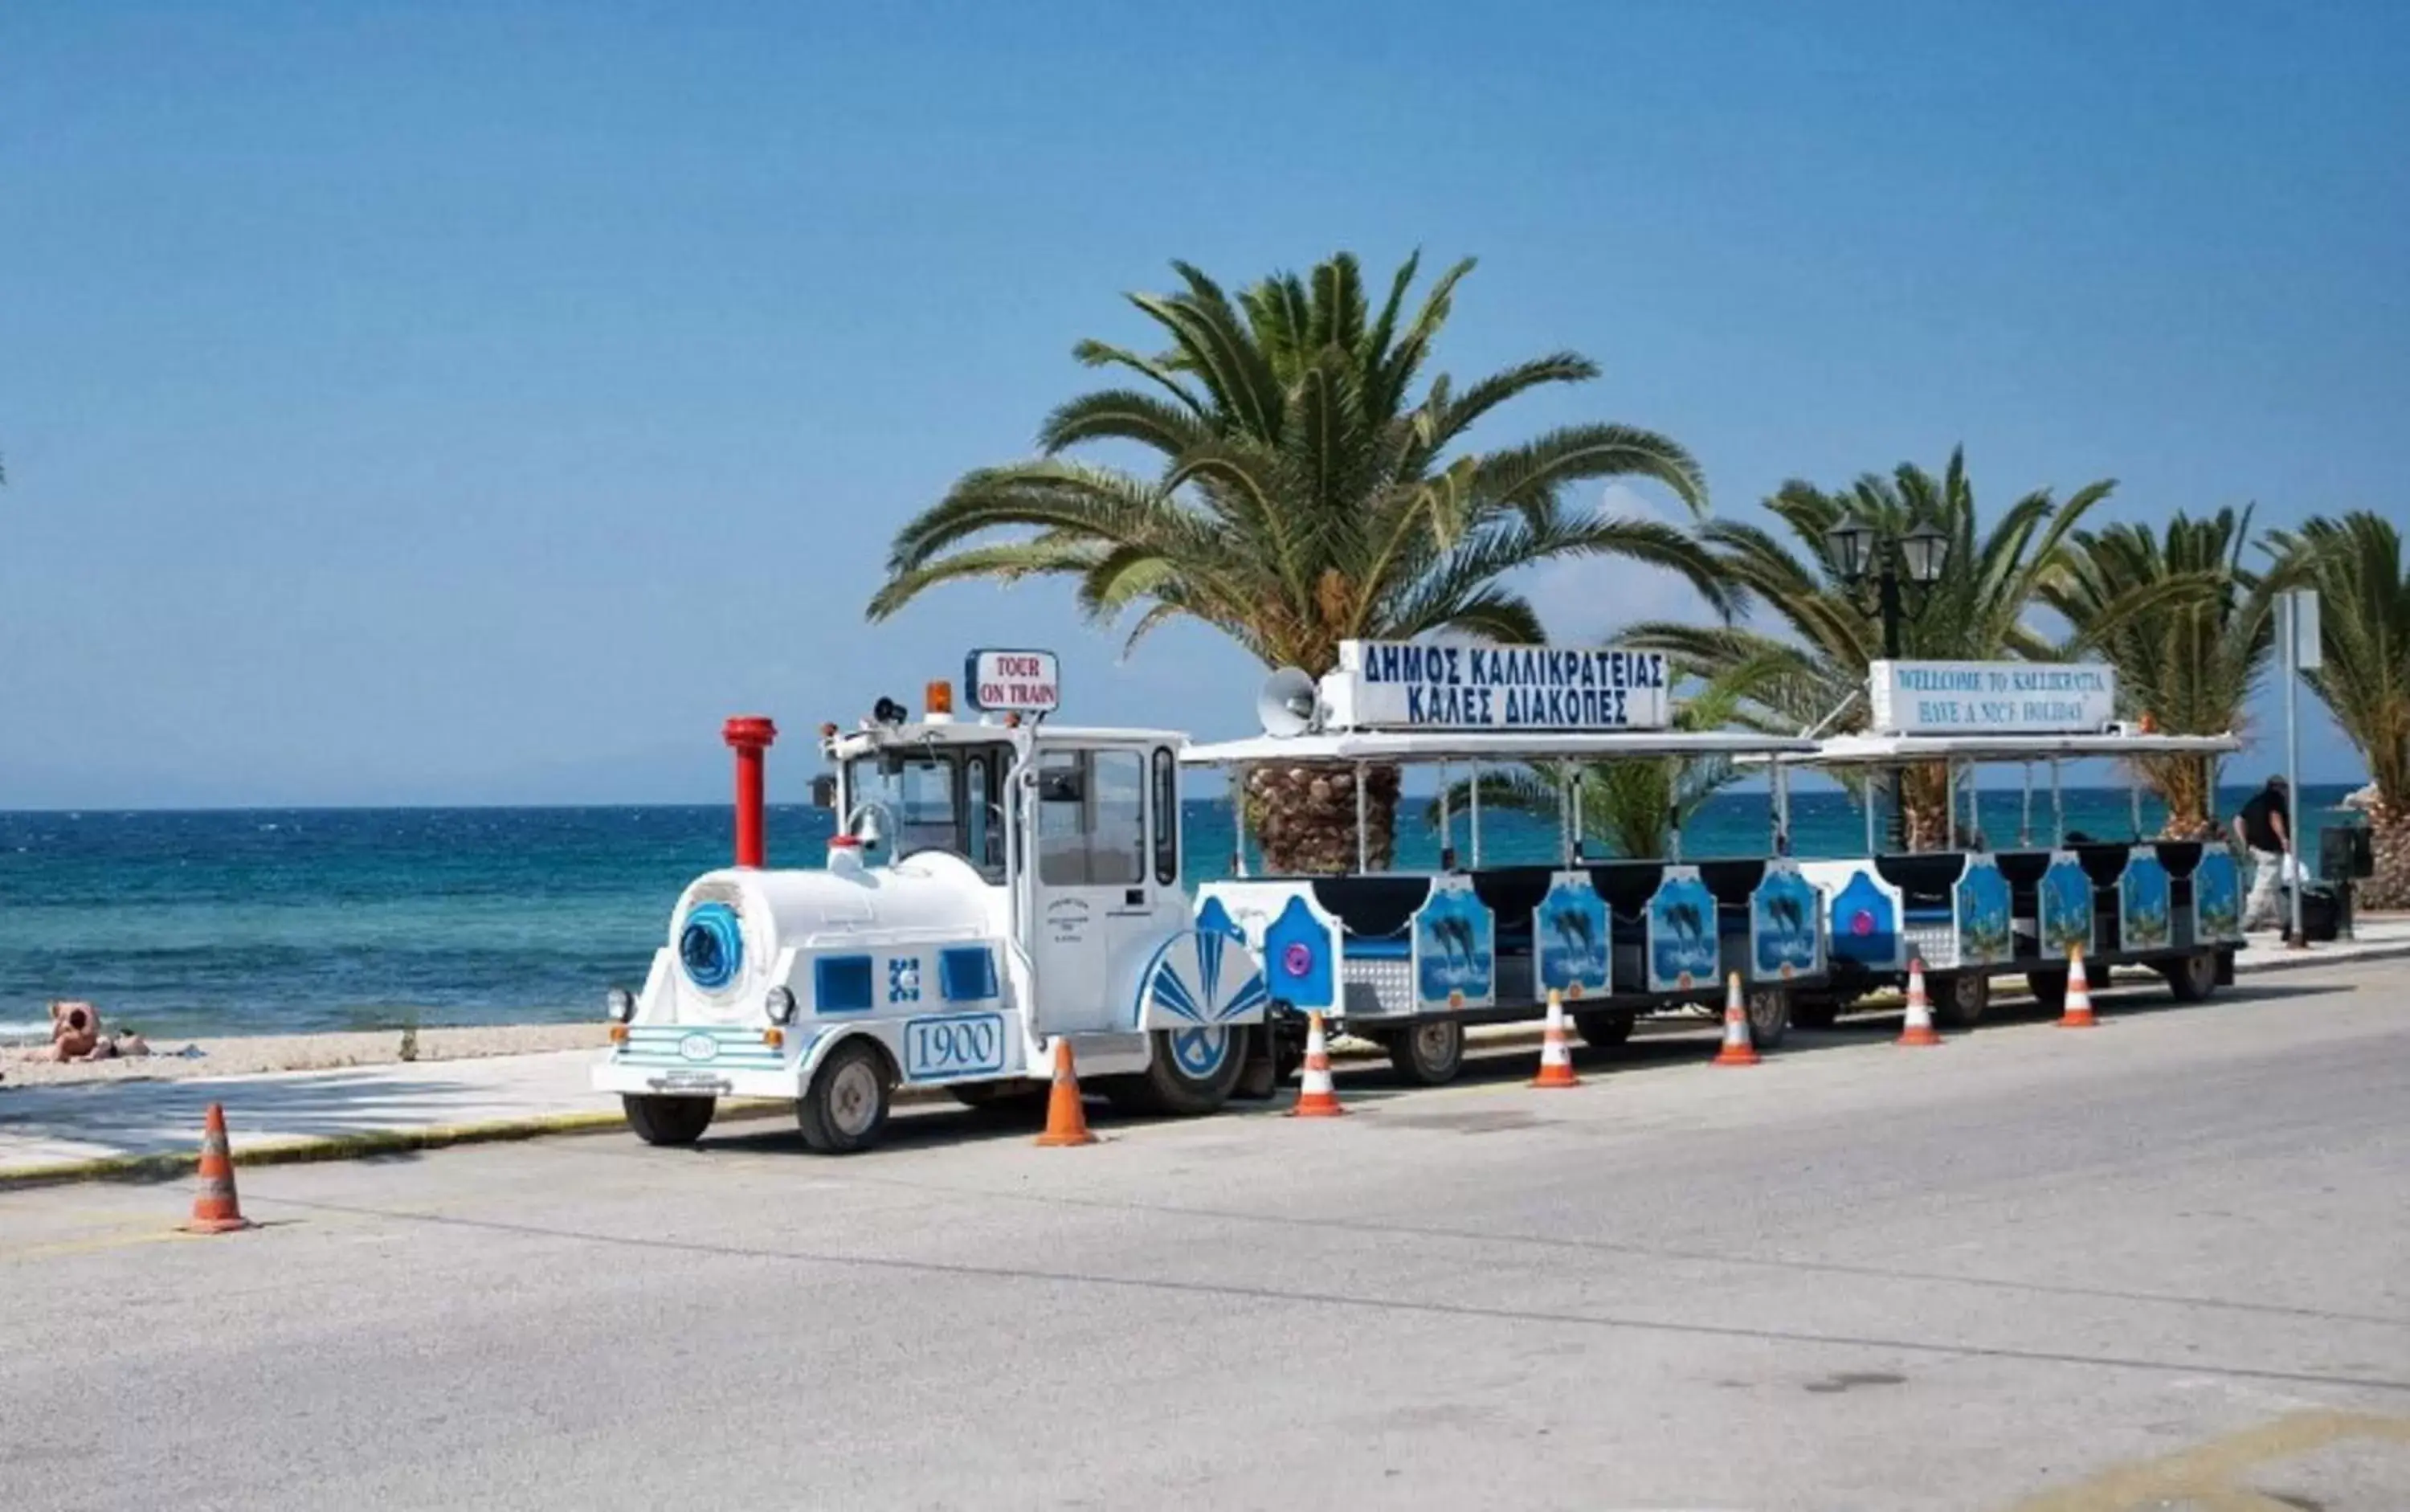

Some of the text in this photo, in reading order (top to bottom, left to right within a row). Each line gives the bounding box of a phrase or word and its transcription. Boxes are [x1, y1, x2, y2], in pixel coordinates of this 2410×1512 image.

[997, 656, 1040, 677] TOUR
[1366, 645, 1664, 689] ΔΗΜΟΣ ΚΑΛΛΙΚΡΑΤΕΙΑΣ
[981, 683, 1056, 704] ON TRAIN
[1987, 672, 2008, 693] TO
[1408, 685, 1628, 724] ΚΑΛΕΣ ΔΙΑΚΟΠΕΣ
[1918, 701, 2083, 723] HAVE A NICE HOLIDAY
[918, 1022, 993, 1068] 1900
